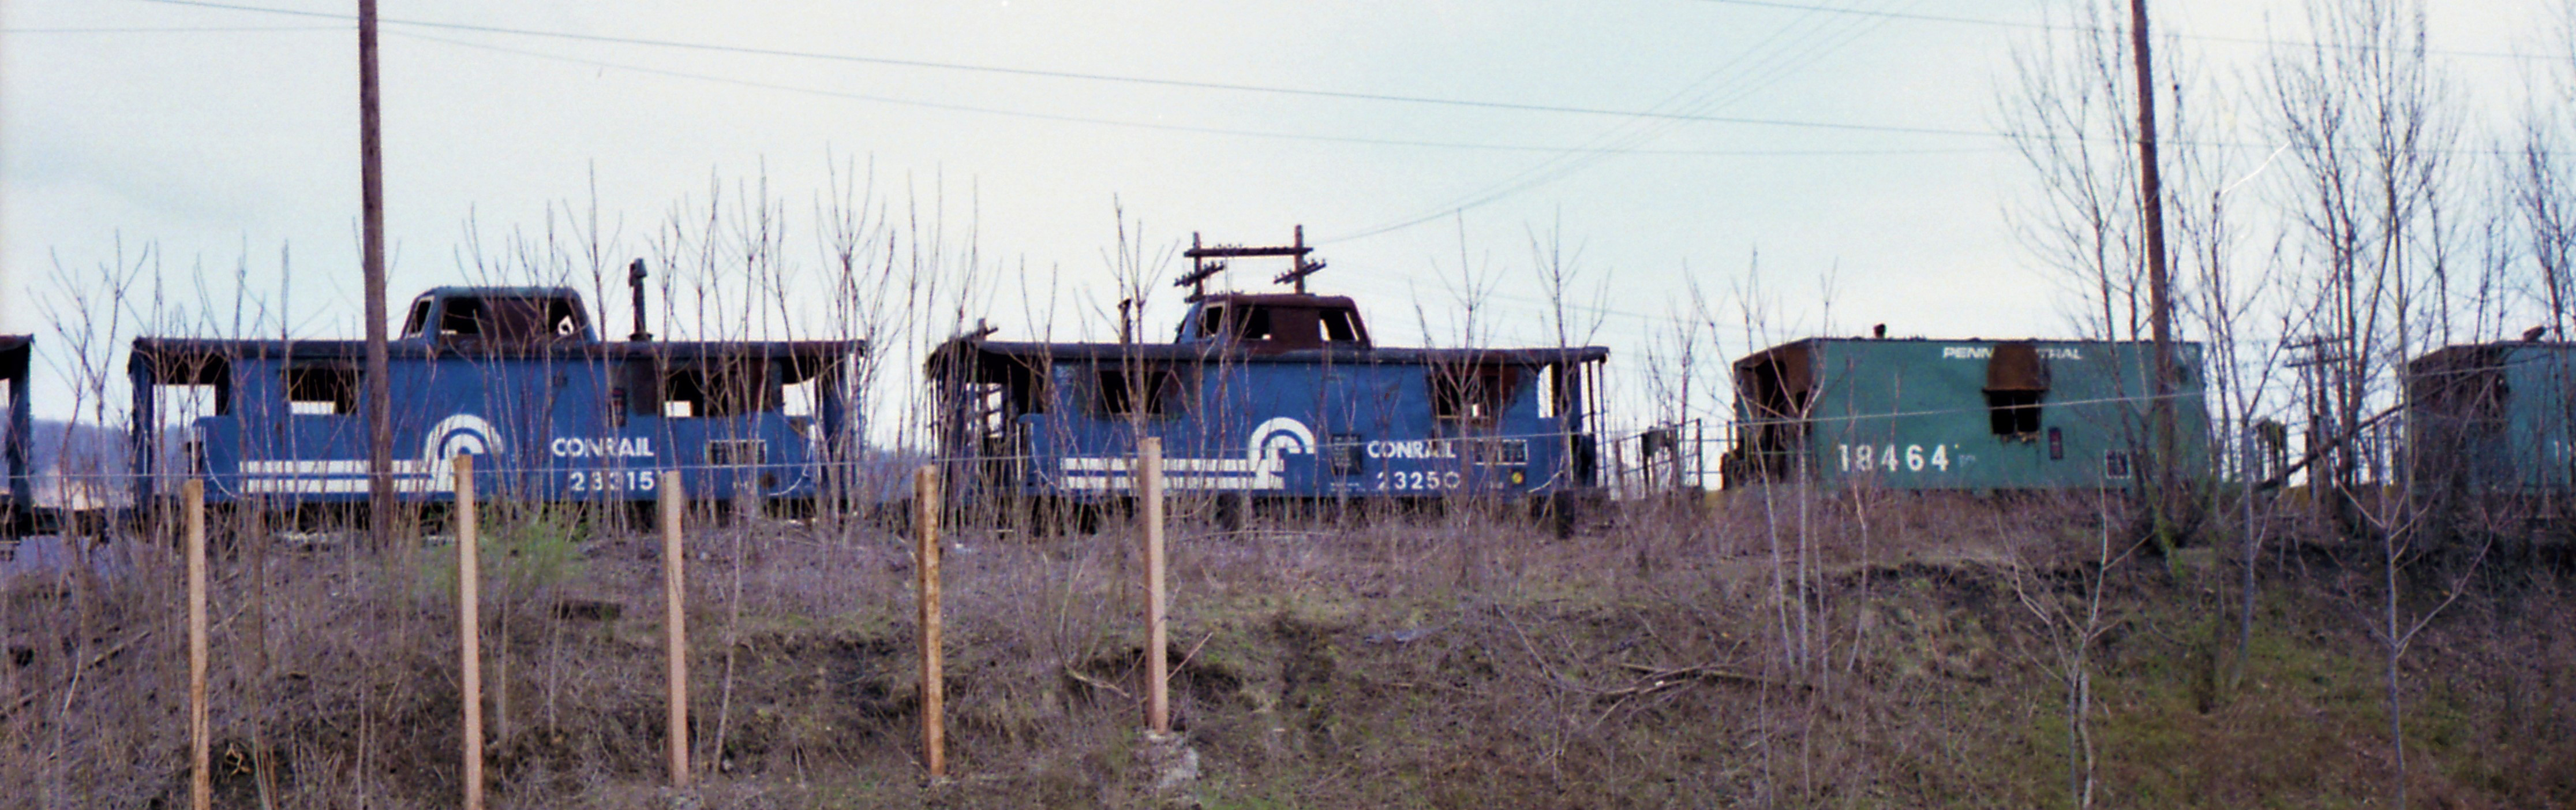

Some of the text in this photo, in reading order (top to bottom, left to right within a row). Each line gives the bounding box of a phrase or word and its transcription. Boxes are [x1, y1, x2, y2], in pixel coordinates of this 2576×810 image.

[1942, 346, 1995, 359] PENN
[552, 437, 655, 457] CONRAIL
[1838, 443, 1950, 472] 18464
